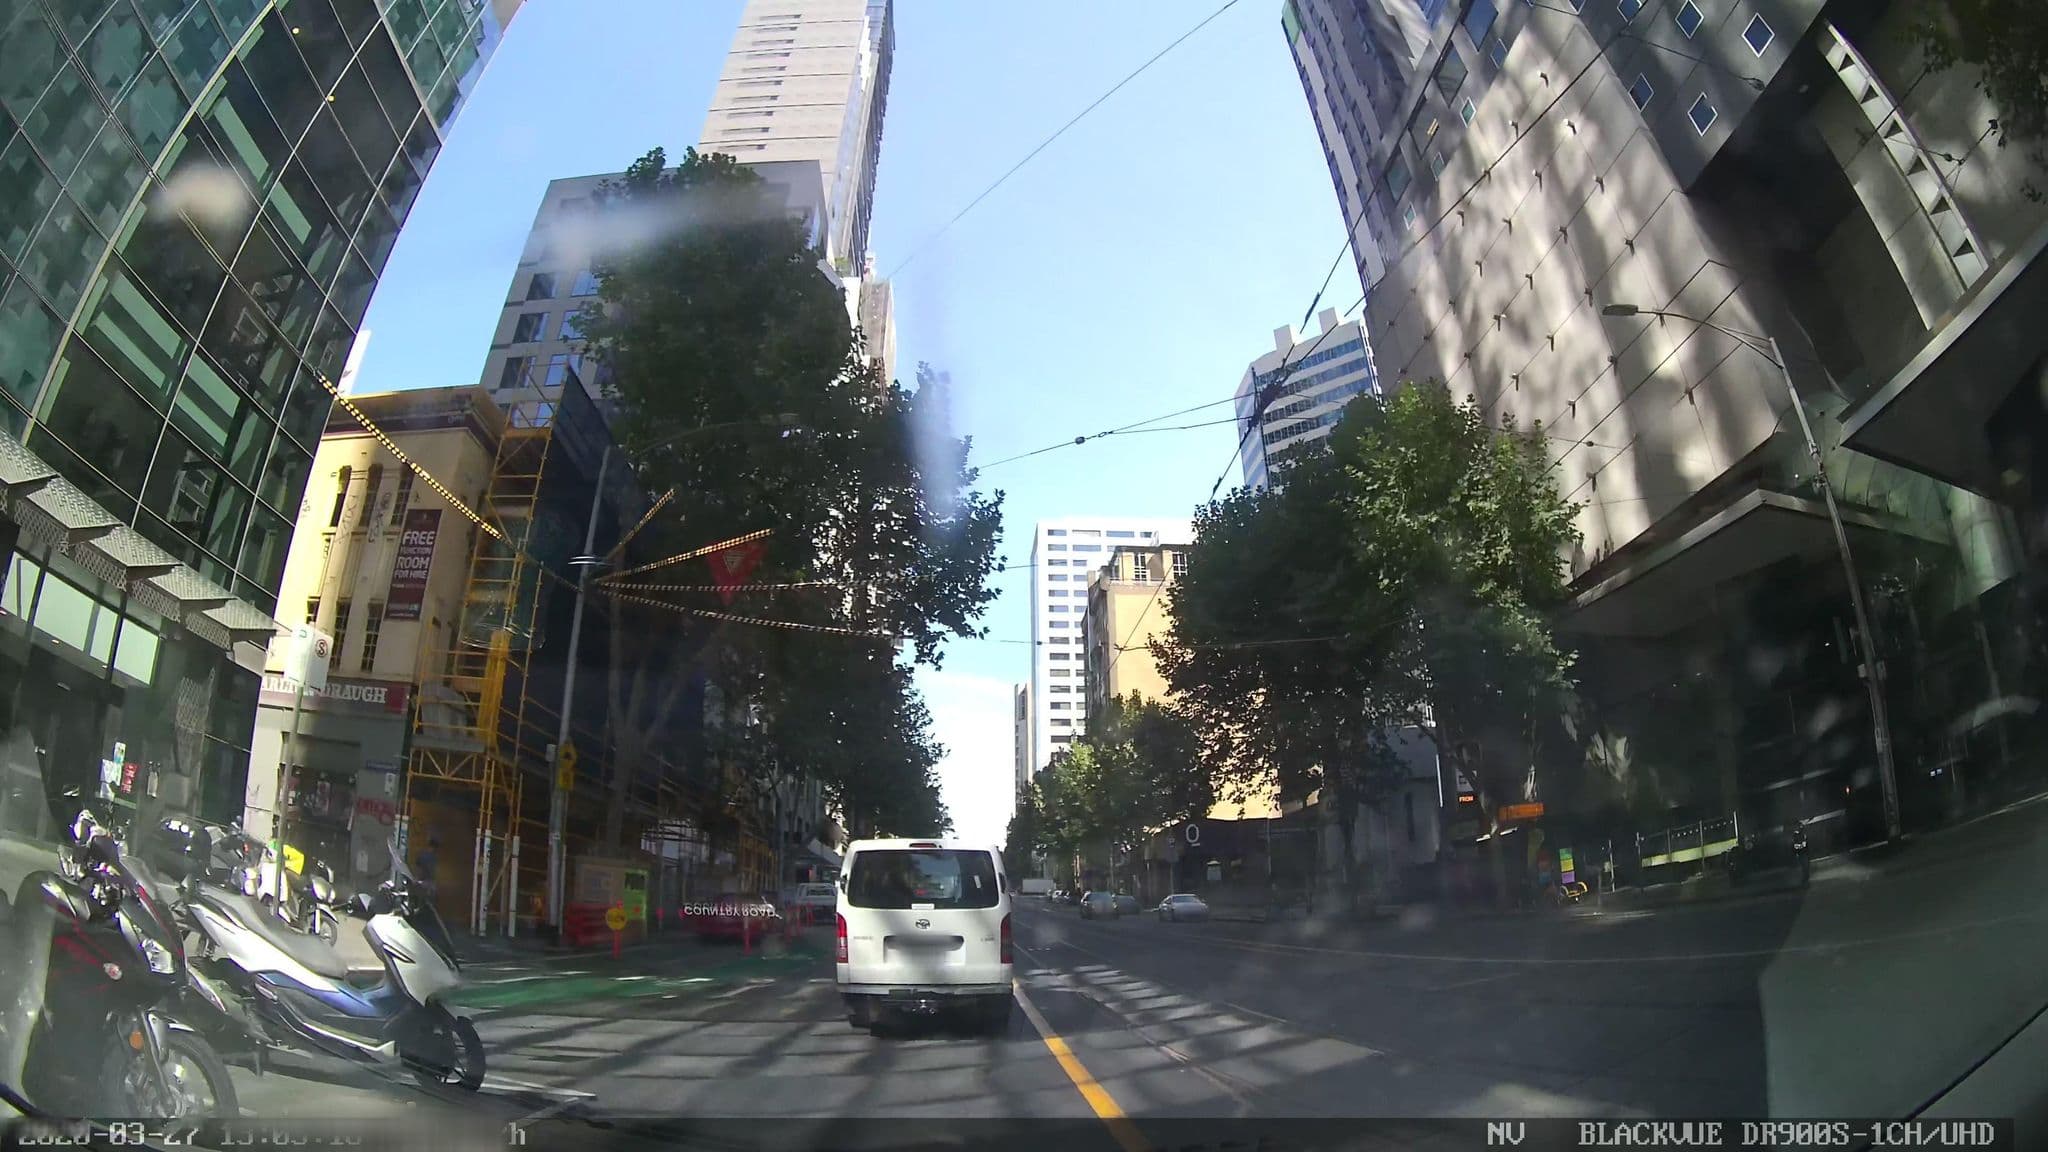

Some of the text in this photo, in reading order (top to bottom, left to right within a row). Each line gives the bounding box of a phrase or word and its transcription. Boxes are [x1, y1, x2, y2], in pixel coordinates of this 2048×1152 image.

[402, 530, 435, 545] FREE
[397, 556, 430, 569] ROOM
[394, 569, 409, 578] FOR
